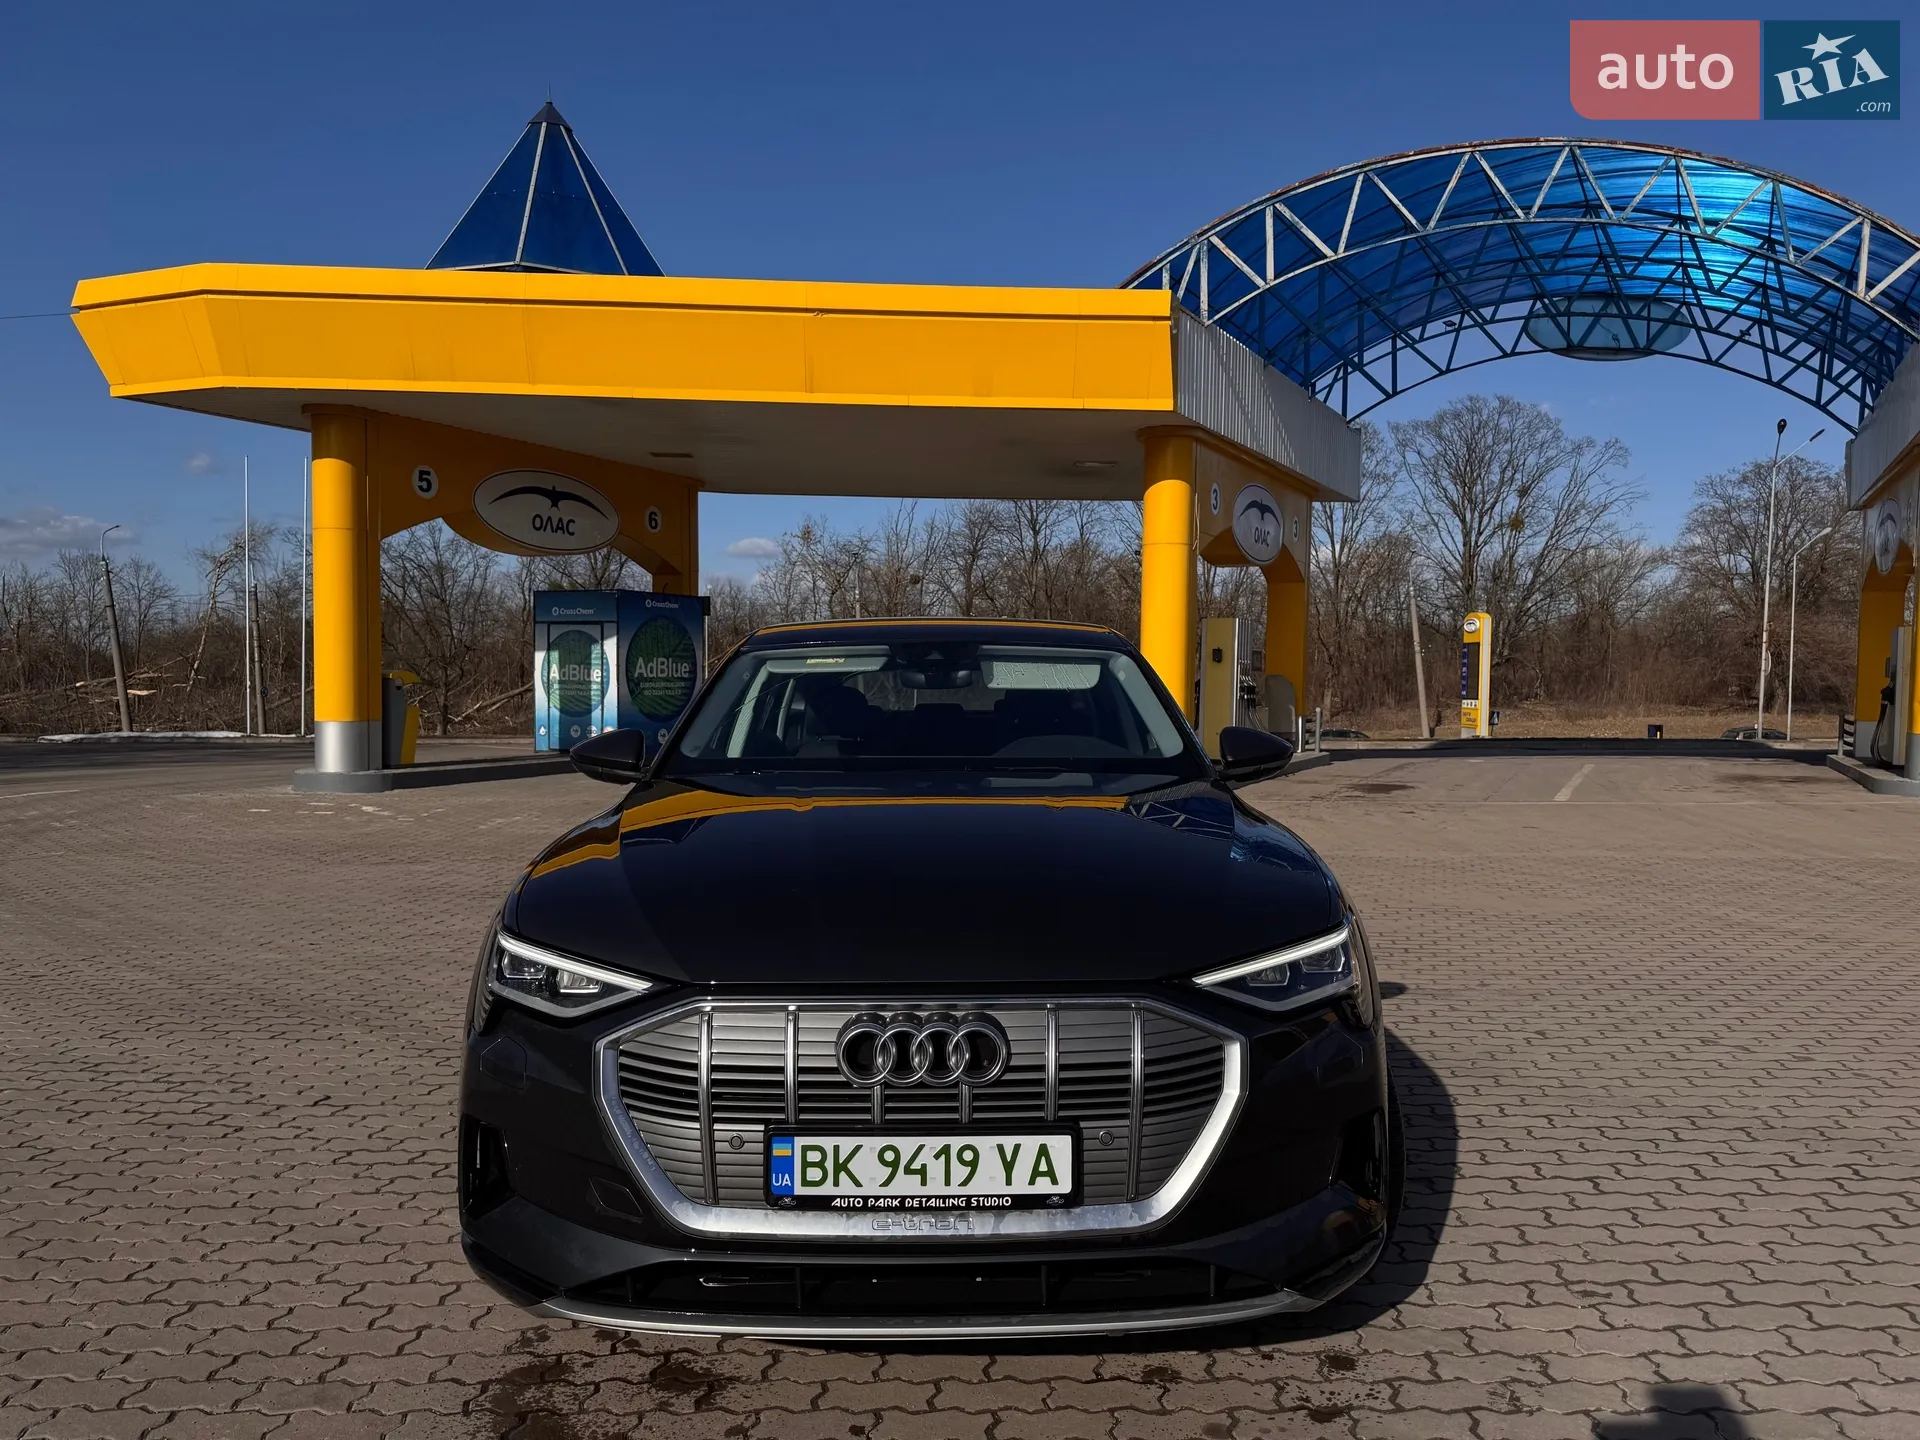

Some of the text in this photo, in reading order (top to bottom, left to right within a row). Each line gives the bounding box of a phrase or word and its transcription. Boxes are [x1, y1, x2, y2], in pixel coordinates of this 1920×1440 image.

[417, 469, 433, 493] 5
[1212, 488, 1218, 511] 3
[648, 510, 659, 530] 6
[549, 663, 602, 681] AdBlue
[634, 657, 690, 678] AdBlue
[772, 1142, 1059, 1188] UA BK 9419 YA
[831, 1196, 1012, 1208] AUTO PARK DETAILING STUDIO
[871, 1215, 974, 1231] e-tron
